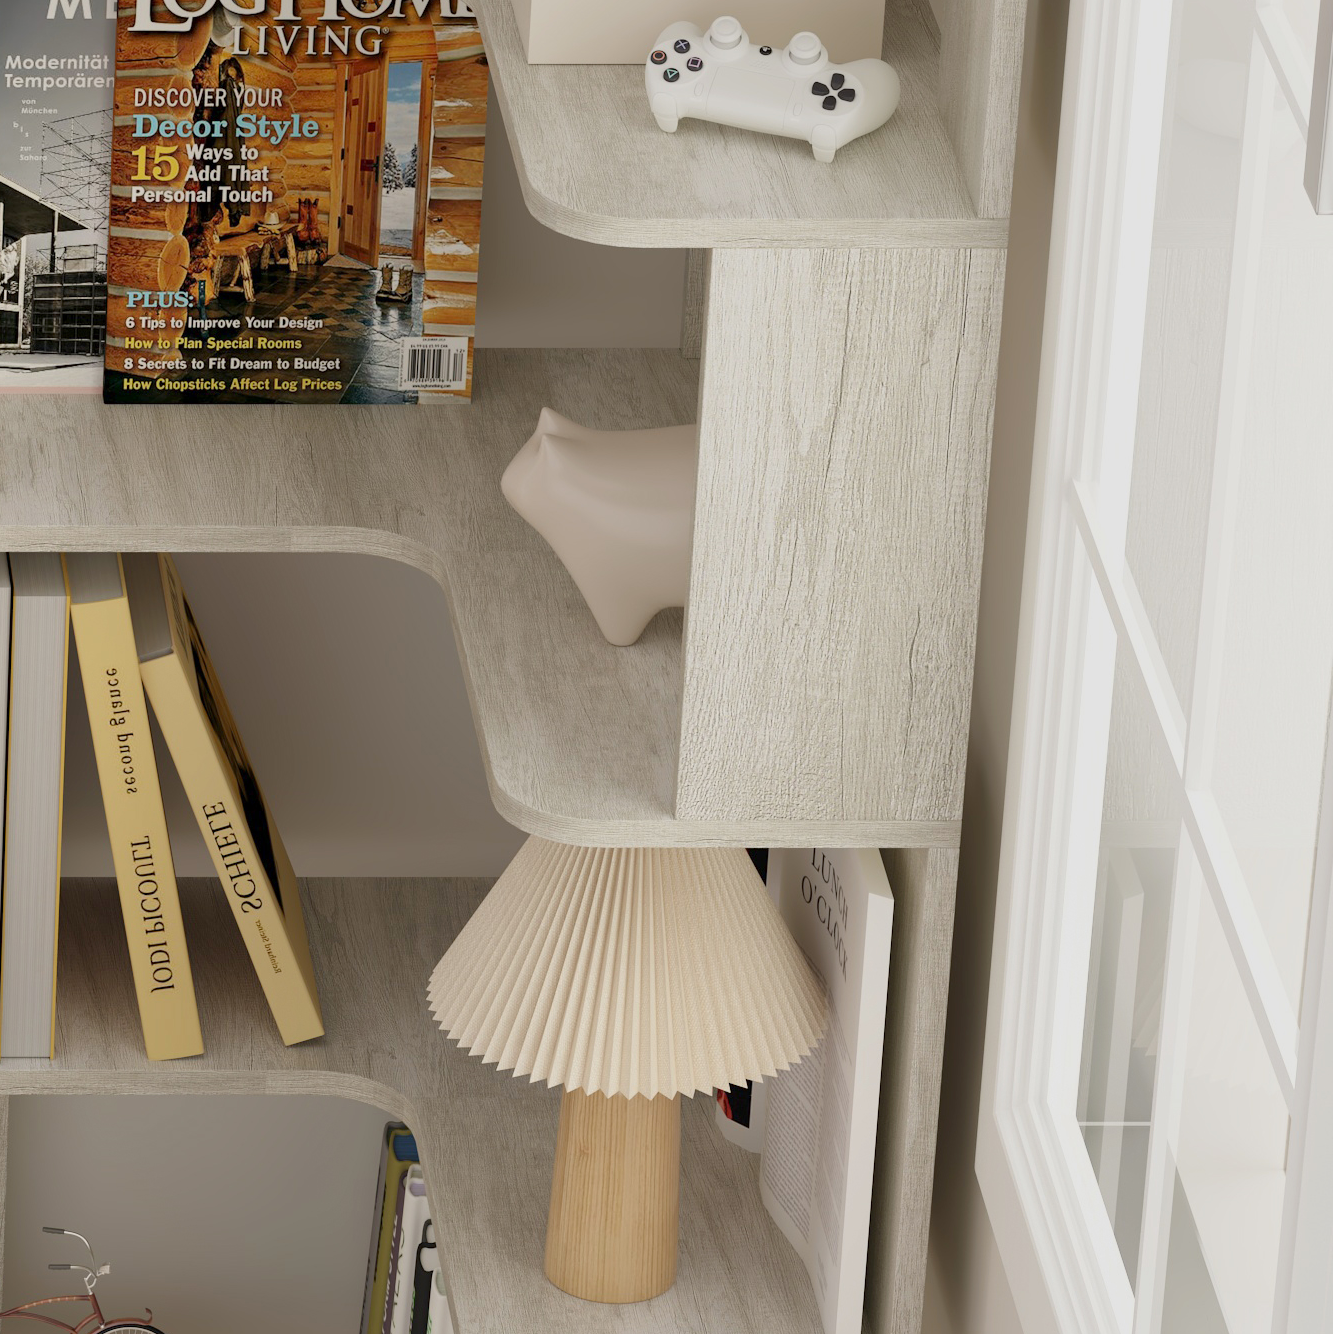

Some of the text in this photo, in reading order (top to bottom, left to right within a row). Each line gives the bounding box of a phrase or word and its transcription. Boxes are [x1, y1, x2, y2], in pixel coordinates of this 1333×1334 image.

[126, 291, 194, 308] PLUS:
[125, 317, 323, 331] 6 Tips to Improve Your Design
[124, 338, 302, 351] How to Plan Special Rooms
[138, 358, 187, 370] Secrets
[191, 358, 204, 370] to
[208, 358, 226, 370] Fit
[230, 358, 273, 370] Dream
[277, 358, 290, 370] to
[294, 358, 341, 372] Budget
[123, 378, 342, 392] How Chopsticks Affect Log Prices
[812, 848, 848, 931] LUNCH
[802, 875, 847, 983] O'CLOCK
